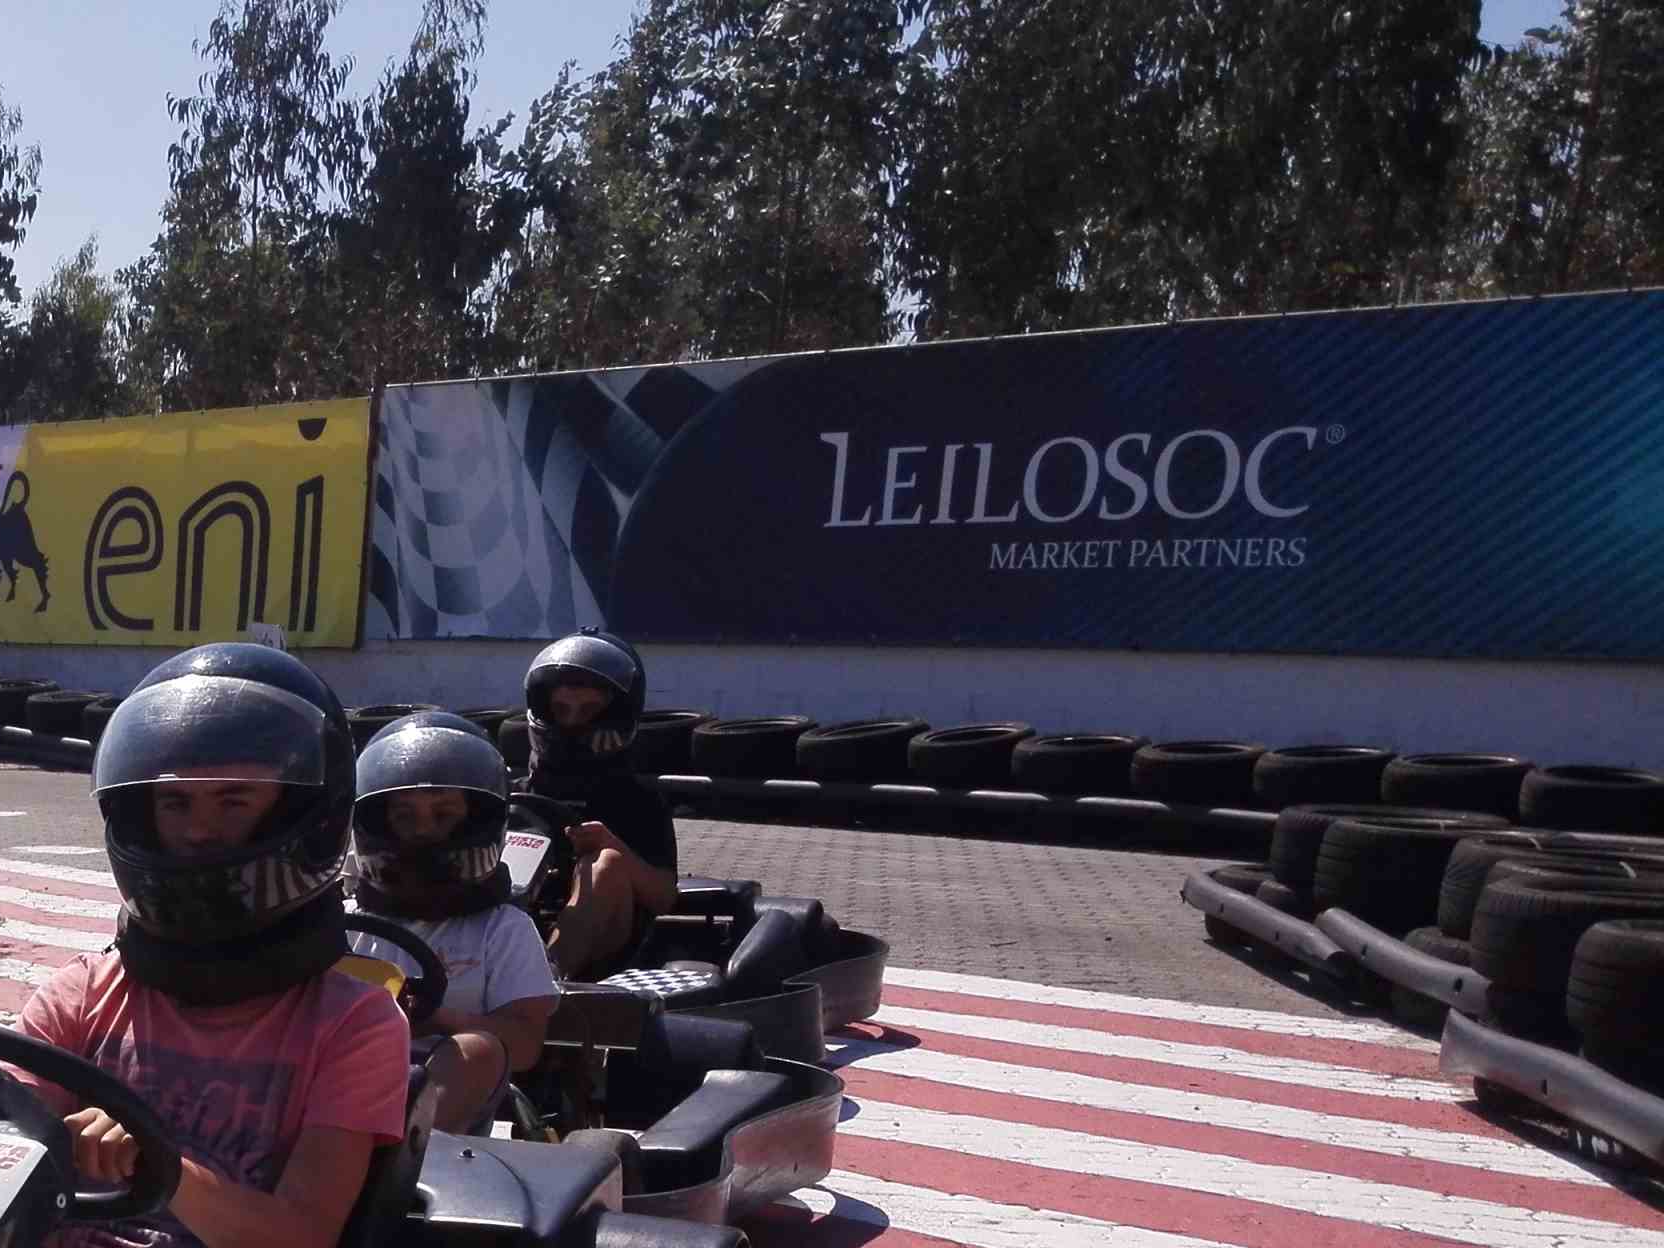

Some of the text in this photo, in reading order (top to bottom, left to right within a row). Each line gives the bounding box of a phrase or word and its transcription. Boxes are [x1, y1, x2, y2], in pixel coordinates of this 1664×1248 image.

[83, 417, 327, 632] eni
[820, 425, 1318, 528] LEILOSOC
[988, 537, 1308, 570] MARKET PARTNERS
